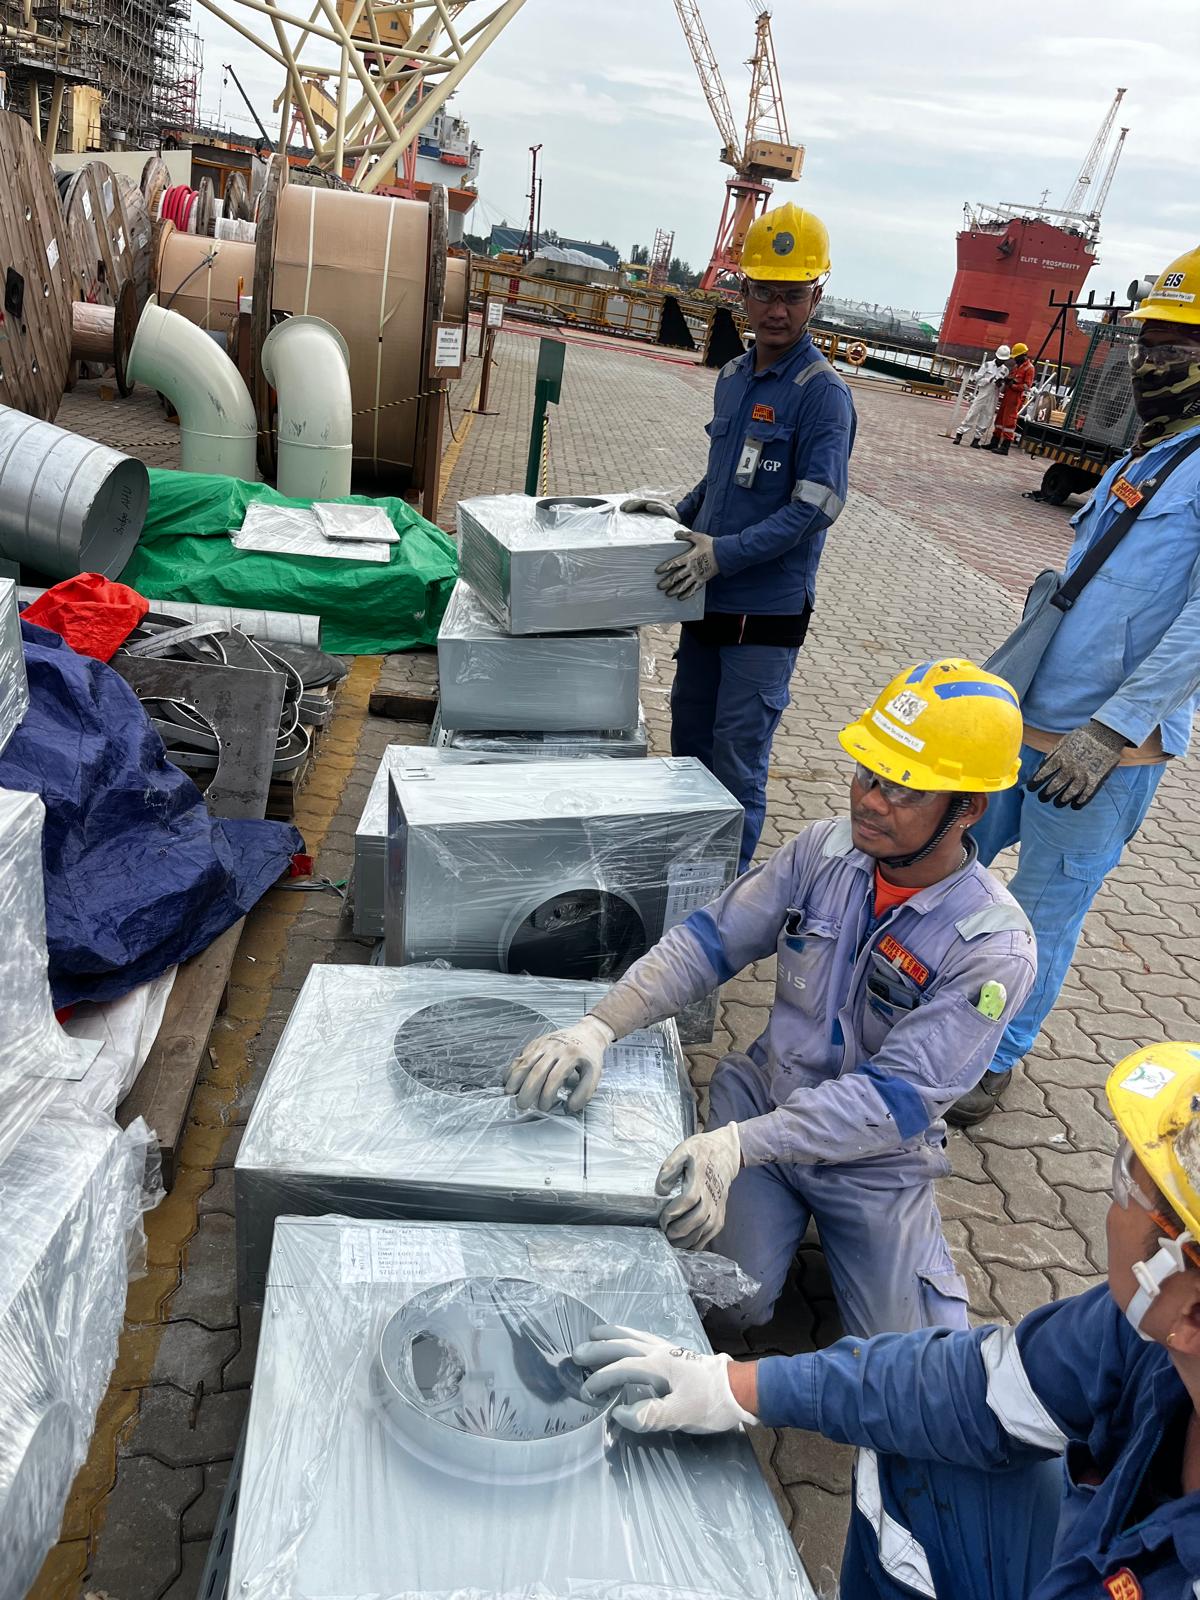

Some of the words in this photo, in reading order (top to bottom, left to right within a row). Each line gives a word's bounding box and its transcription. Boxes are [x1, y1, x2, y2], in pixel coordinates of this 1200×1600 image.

[1020, 256, 1038, 264] ELITE
[1042, 259, 1080, 270] PROSPERITY
[1163, 273, 1184, 287] EIS
[885, 937, 910, 960] SAFETY
[910, 963, 926, 982] ME
